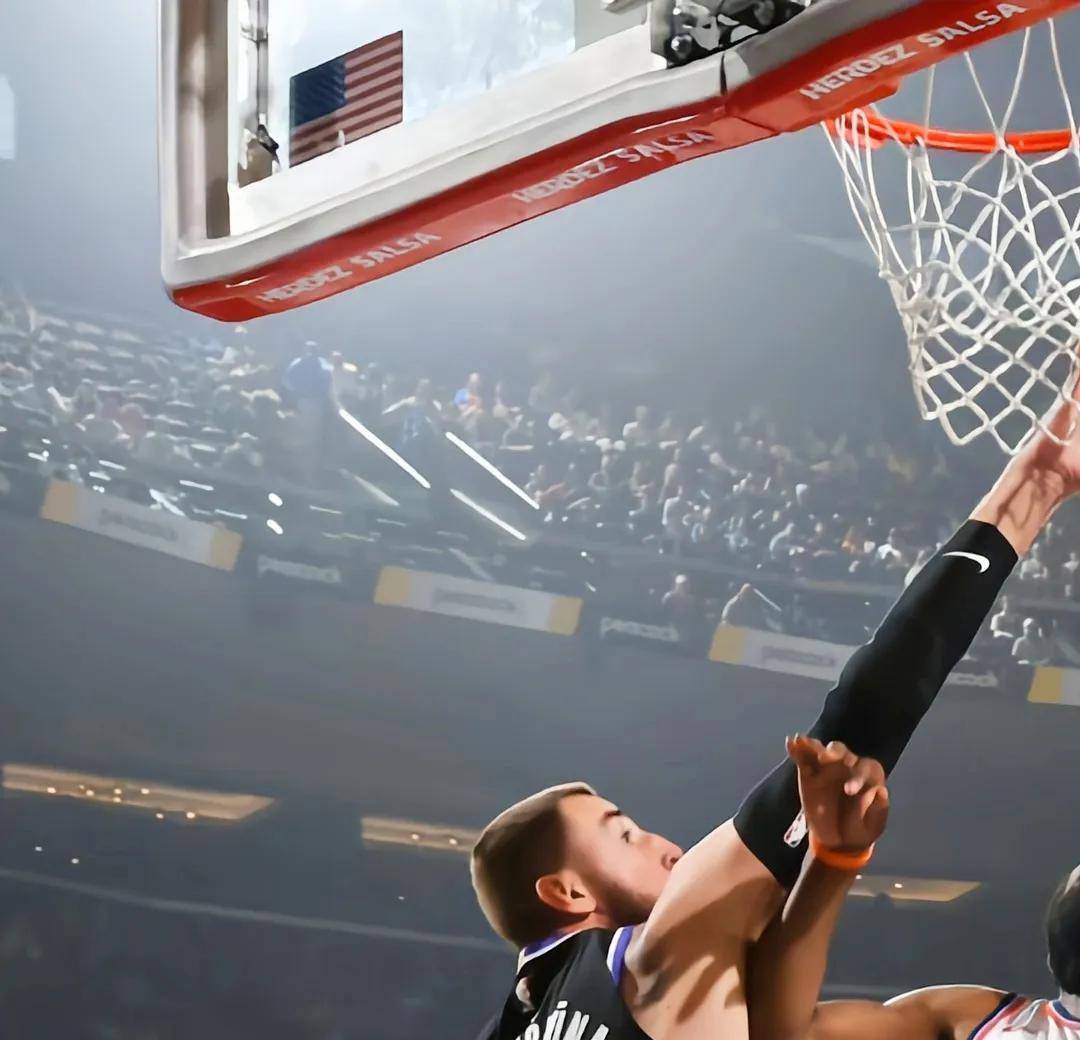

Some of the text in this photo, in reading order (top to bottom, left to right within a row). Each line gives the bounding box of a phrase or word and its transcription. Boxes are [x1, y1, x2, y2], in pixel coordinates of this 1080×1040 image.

[799, 2, 1028, 100] HERDEZ SALSA
[347, 231, 442, 269] SALSA
